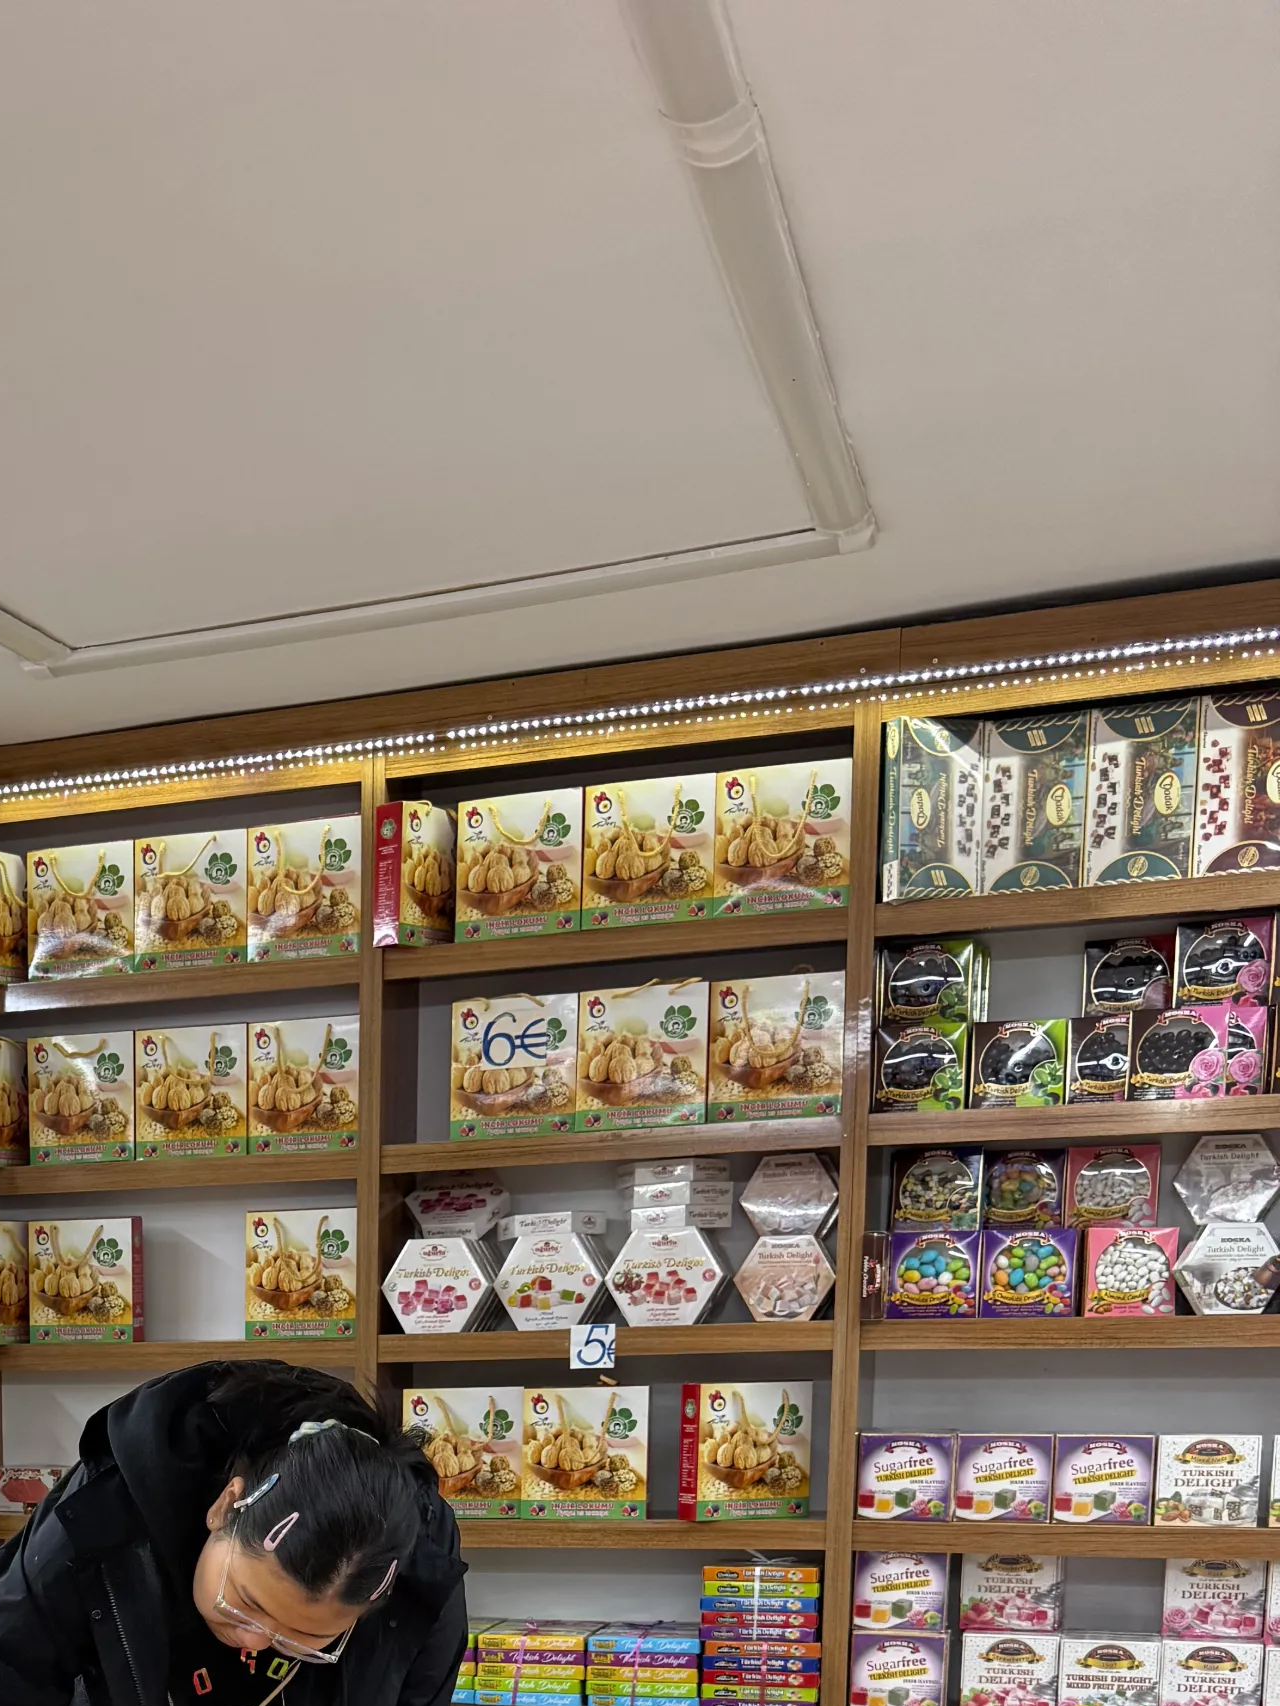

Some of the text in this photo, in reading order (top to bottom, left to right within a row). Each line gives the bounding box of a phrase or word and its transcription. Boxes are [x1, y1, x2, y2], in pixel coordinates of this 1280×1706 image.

[482, 1012, 549, 1067] 6€
[1199, 1152, 1260, 1163] Turkish Delight
[1207, 1244, 1265, 1256] Turkish Delight
[873, 1456, 934, 1474] Sugarfree
[972, 1456, 1034, 1475] Sugarfree
[1070, 1457, 1135, 1476] Sugarfree
[875, 1468, 935, 1483] TURKISH DELIGHT
[974, 1469, 1036, 1484] TURKISH DELIGHT
[1072, 1469, 1136, 1485] TURKISH DELIGHT
[1181, 1469, 1234, 1477] TURKISH
[1174, 1477, 1243, 1488] DELIGHT
[870, 1568, 930, 1584] Sugarfree
[984, 1576, 1033, 1585] TURKISH
[872, 1580, 931, 1593] TURKISH DELIGHT
[977, 1584, 1041, 1594] DELIGHT
[1188, 1582, 1241, 1591] TURKISH
[1180, 1590, 1249, 1600] DELIGHT
[866, 1656, 927, 1672] Sugarfree
[868, 1667, 928, 1681] TURKISH DELIGHT
[984, 1667, 1035, 1676] TURKISH
[978, 1675, 1043, 1686] DELIGHT
[1065, 1674, 1153, 1685] TURKISH DELIGHT
[1184, 1675, 1236, 1685] TURKISH
[1065, 1682, 1115, 1691] MIXED FRUIT
[1176, 1684, 1245, 1695] DELIGHT
